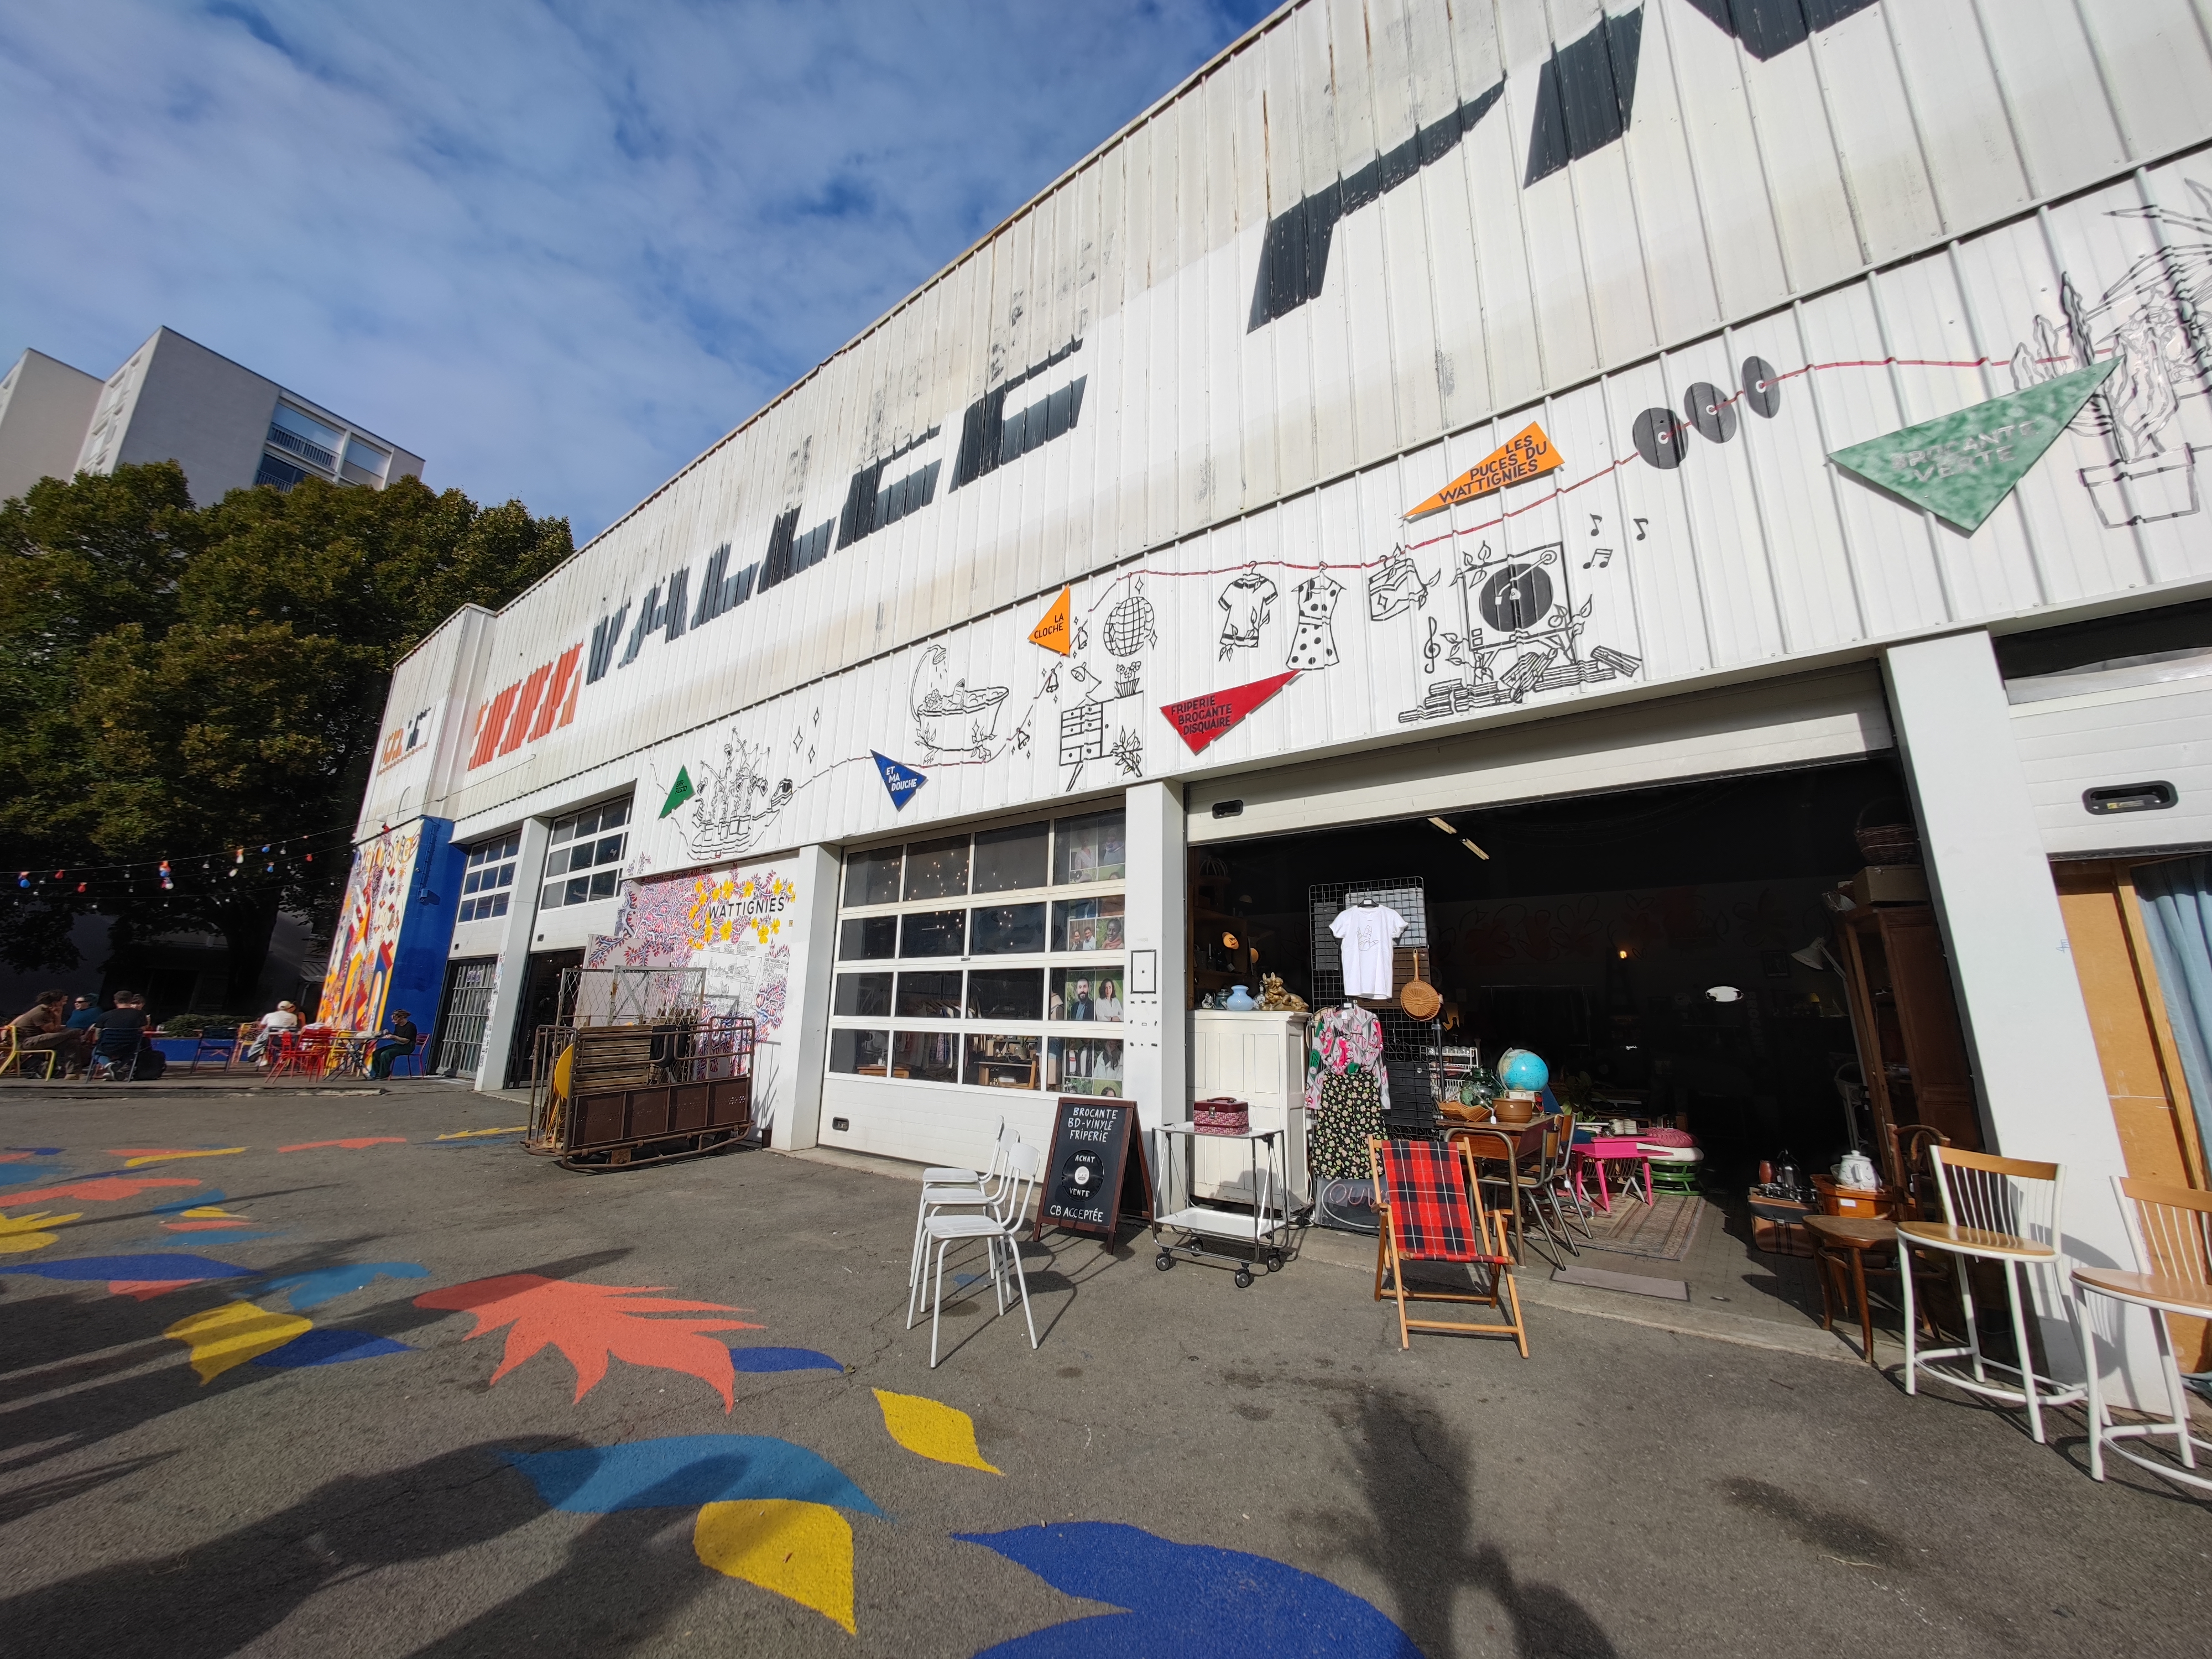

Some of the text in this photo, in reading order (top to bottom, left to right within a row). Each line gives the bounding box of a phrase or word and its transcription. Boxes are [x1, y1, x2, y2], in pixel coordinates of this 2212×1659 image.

[1506, 435, 1532, 455] LES
[1470, 441, 1547, 481] PUCES DU
[1914, 445, 2016, 482] VERTE
[1438, 459, 1538, 503] WATTIGNIES
[1055, 612, 1064, 623] LA
[1034, 622, 1063, 639] CLOCHE
[1171, 695, 1215, 716] FRIPERIE
[1178, 703, 1232, 725] BROCANTE
[1183, 715, 1230, 735] DISQUAIRE
[886, 766, 895, 776] ET
[889, 773, 900, 784] MA
[891, 779, 917, 791] DOUCHE
[709, 896, 785, 919] WATTIGNIES
[1073, 1107, 1119, 1120] BROCANTE
[1070, 1128, 1109, 1143] FRIPERIE
[1074, 1154, 1096, 1163] ACHAT
[1069, 1187, 1091, 1197] VENTE
[1050, 1205, 1104, 1222] CB ACCEPTÉE
